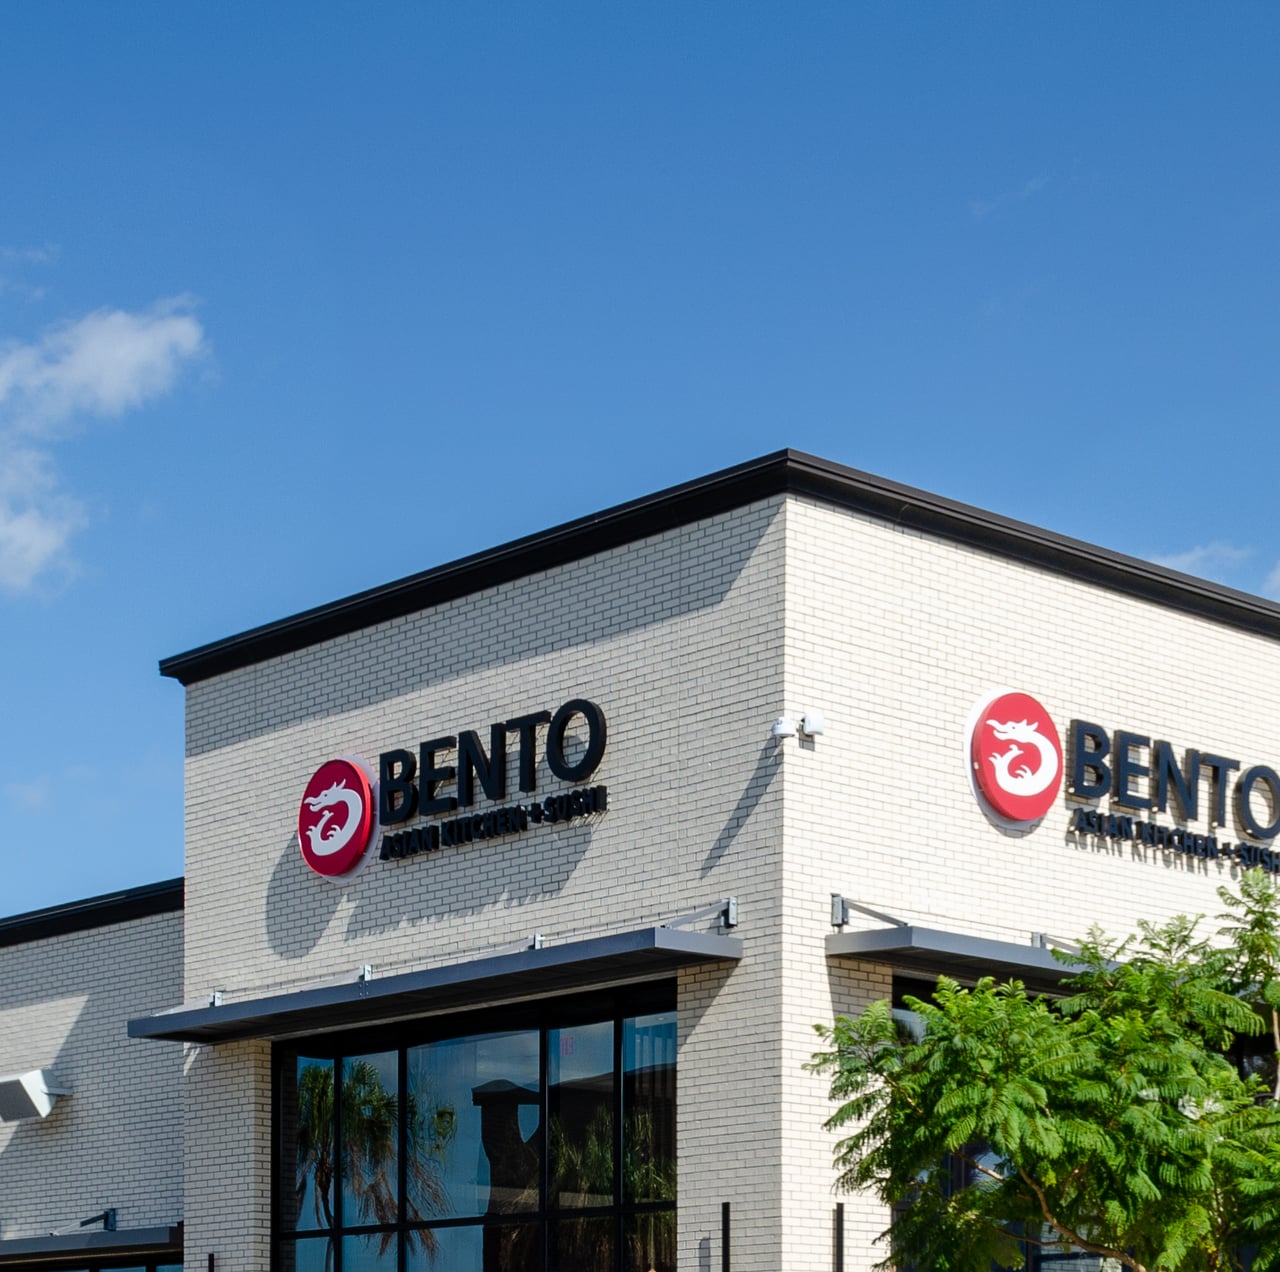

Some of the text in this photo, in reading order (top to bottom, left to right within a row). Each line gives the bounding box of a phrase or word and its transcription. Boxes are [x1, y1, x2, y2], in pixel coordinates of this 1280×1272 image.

[379, 698, 607, 826] BENTO
[380, 825, 440, 861] ASIAN
[440, 803, 528, 847] KITCHEN
[543, 785, 608, 823] SUSHI
[1071, 807, 1133, 841] ASIAN
[1134, 820, 1218, 860] KITCHEN
